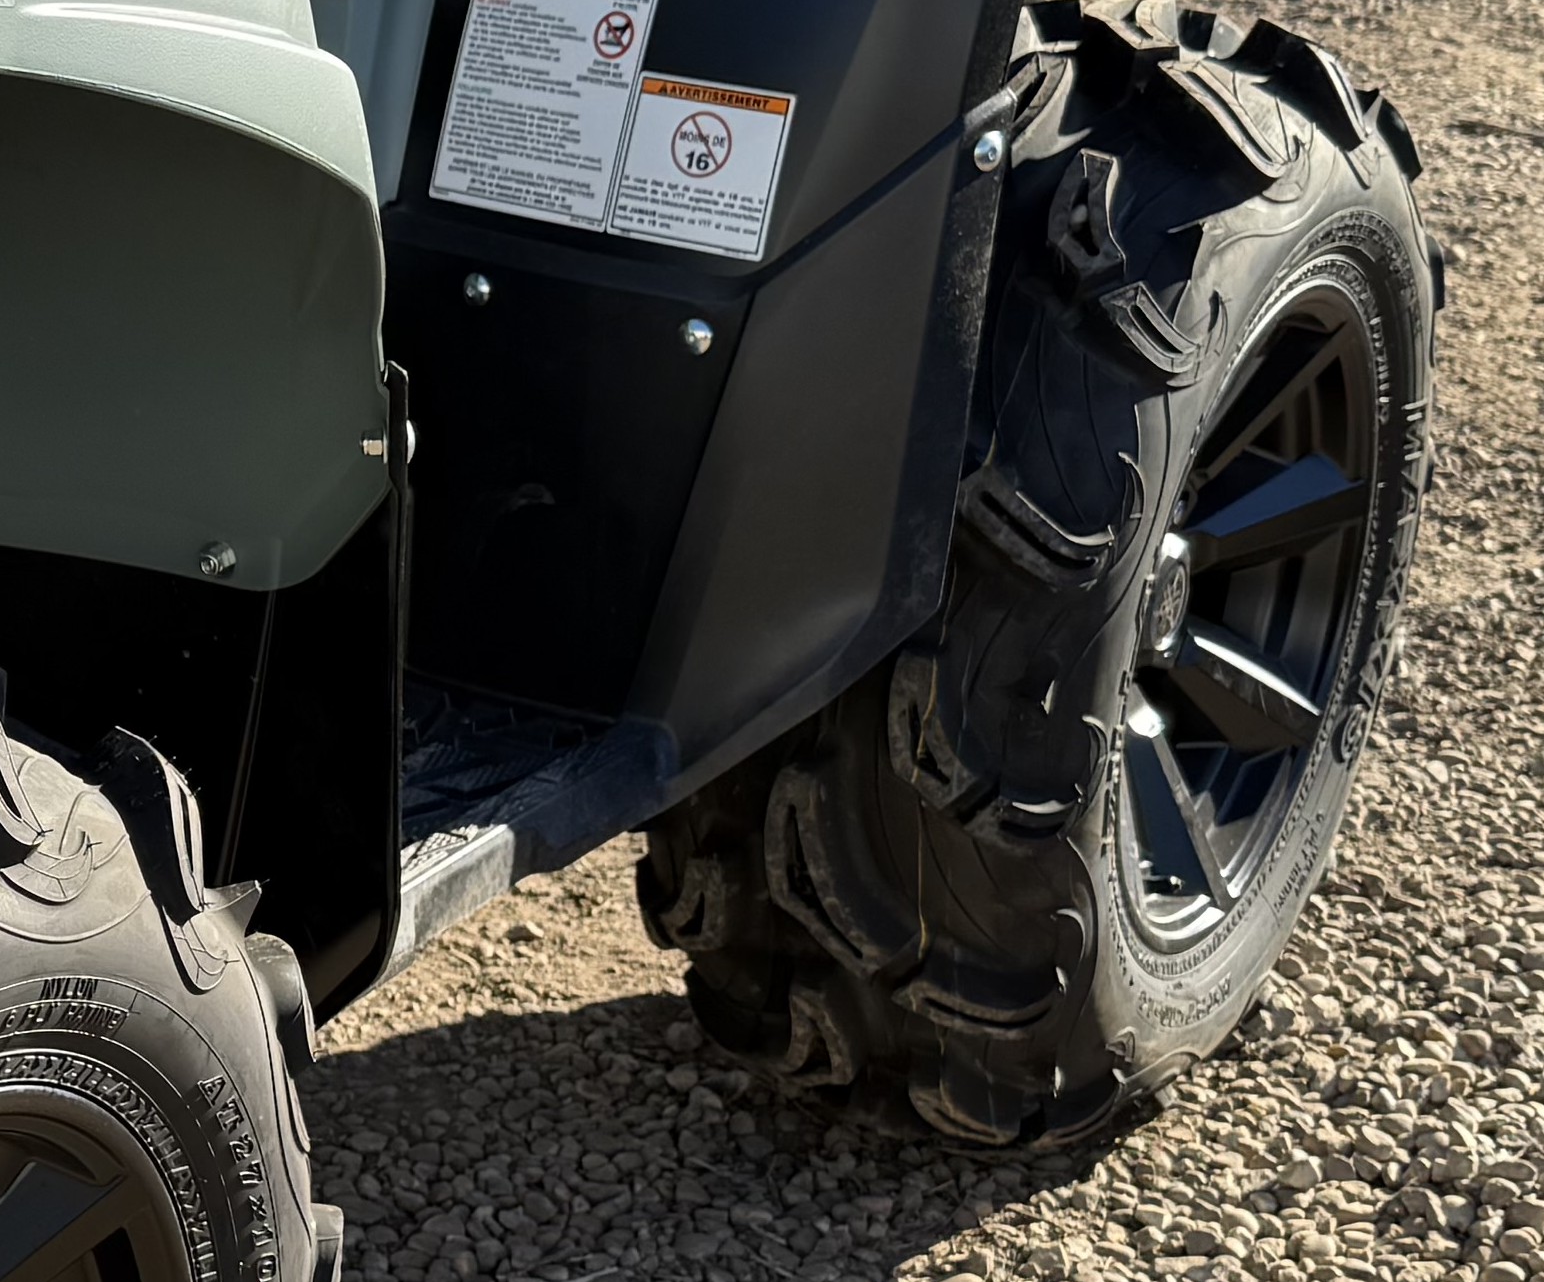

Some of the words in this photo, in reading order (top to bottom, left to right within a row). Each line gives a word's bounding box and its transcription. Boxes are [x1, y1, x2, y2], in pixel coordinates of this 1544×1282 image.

[669, 83, 770, 110] AVERTISSEMENT
[711, 134, 727, 149] DE
[682, 148, 712, 173] 16
